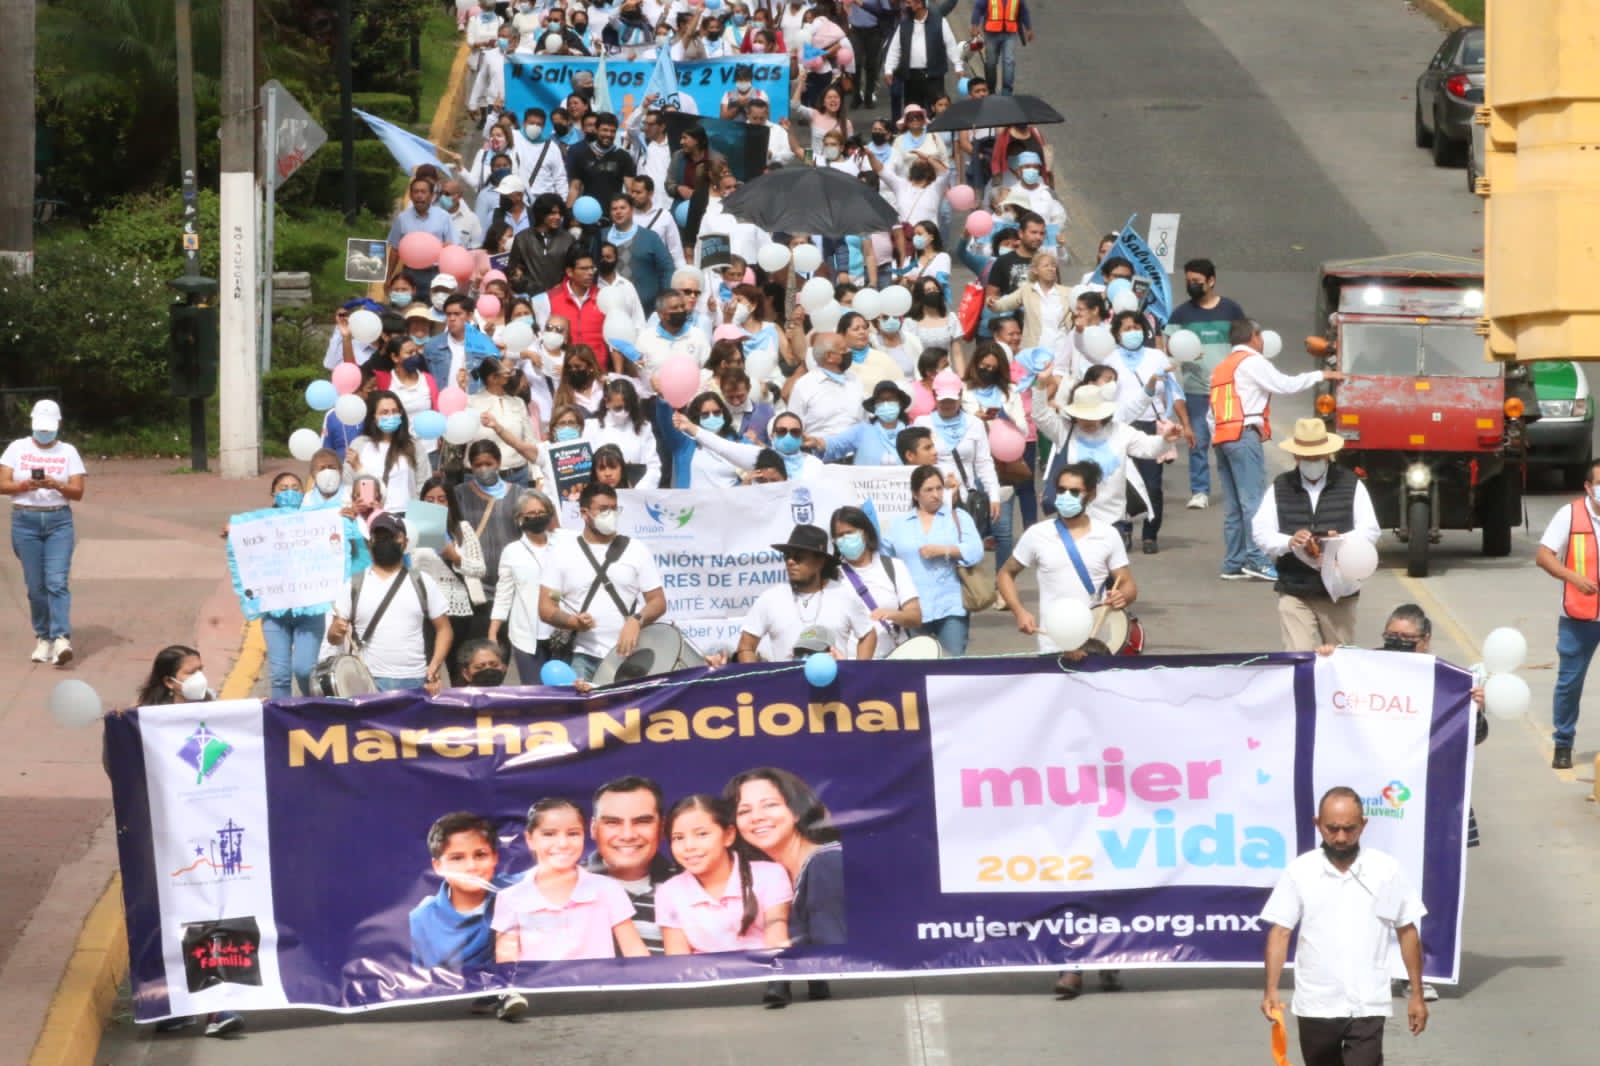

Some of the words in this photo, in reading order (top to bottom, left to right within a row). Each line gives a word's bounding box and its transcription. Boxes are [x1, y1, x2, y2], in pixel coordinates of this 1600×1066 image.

[699, 67, 712, 86] 2
[654, 550, 704, 568] NIÓN
[707, 573, 731, 587] DE
[288, 715, 569, 768] Marcha
[586, 691, 921, 750] Nacional
[959, 746, 1222, 818] mujer
[1096, 808, 1287, 870] vida
[976, 855, 1095, 882] 2022
[917, 911, 1263, 942] mujeryvida.org.mx
